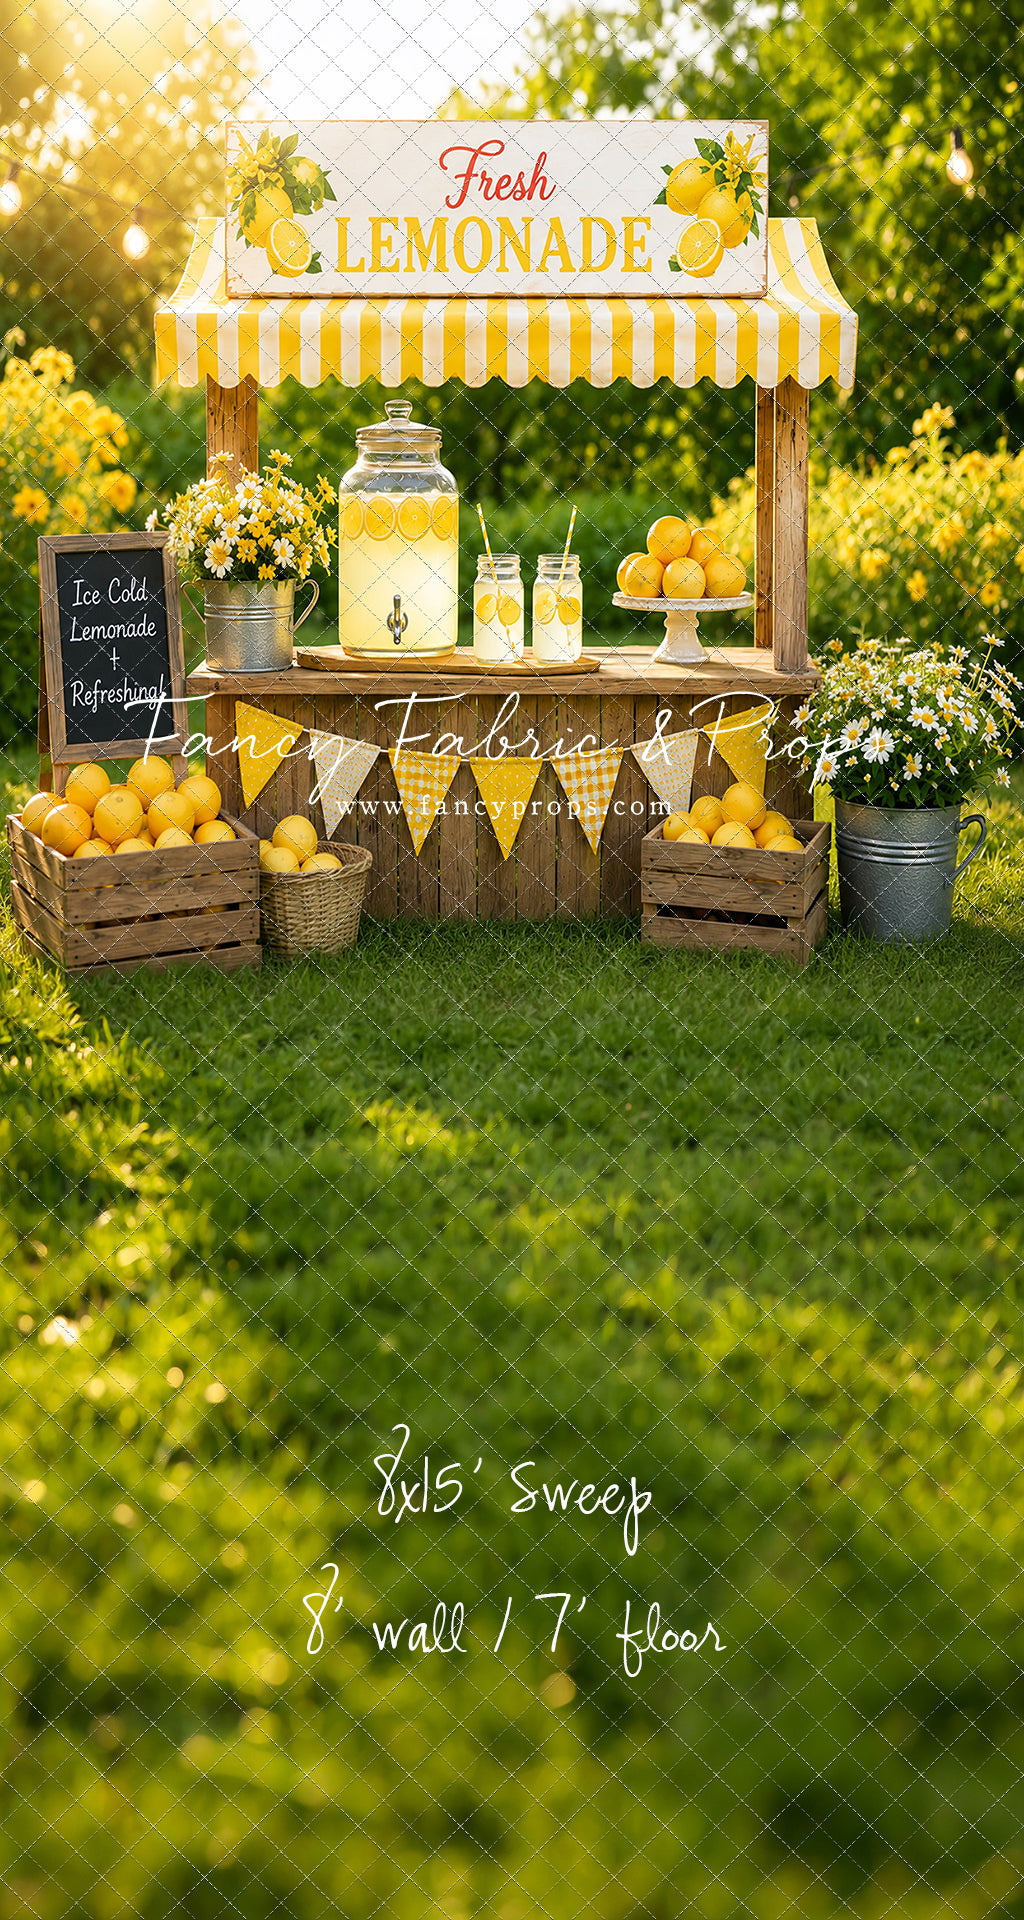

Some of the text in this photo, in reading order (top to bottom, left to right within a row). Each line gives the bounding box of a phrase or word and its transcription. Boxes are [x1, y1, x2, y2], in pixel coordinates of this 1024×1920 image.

[439, 139, 557, 209] Fresh
[334, 216, 653, 274] LEMONADE
[72, 577, 148, 607] Ice Cold
[70, 613, 156, 642] Lemonade
[70, 673, 165, 713] Refreshing!
